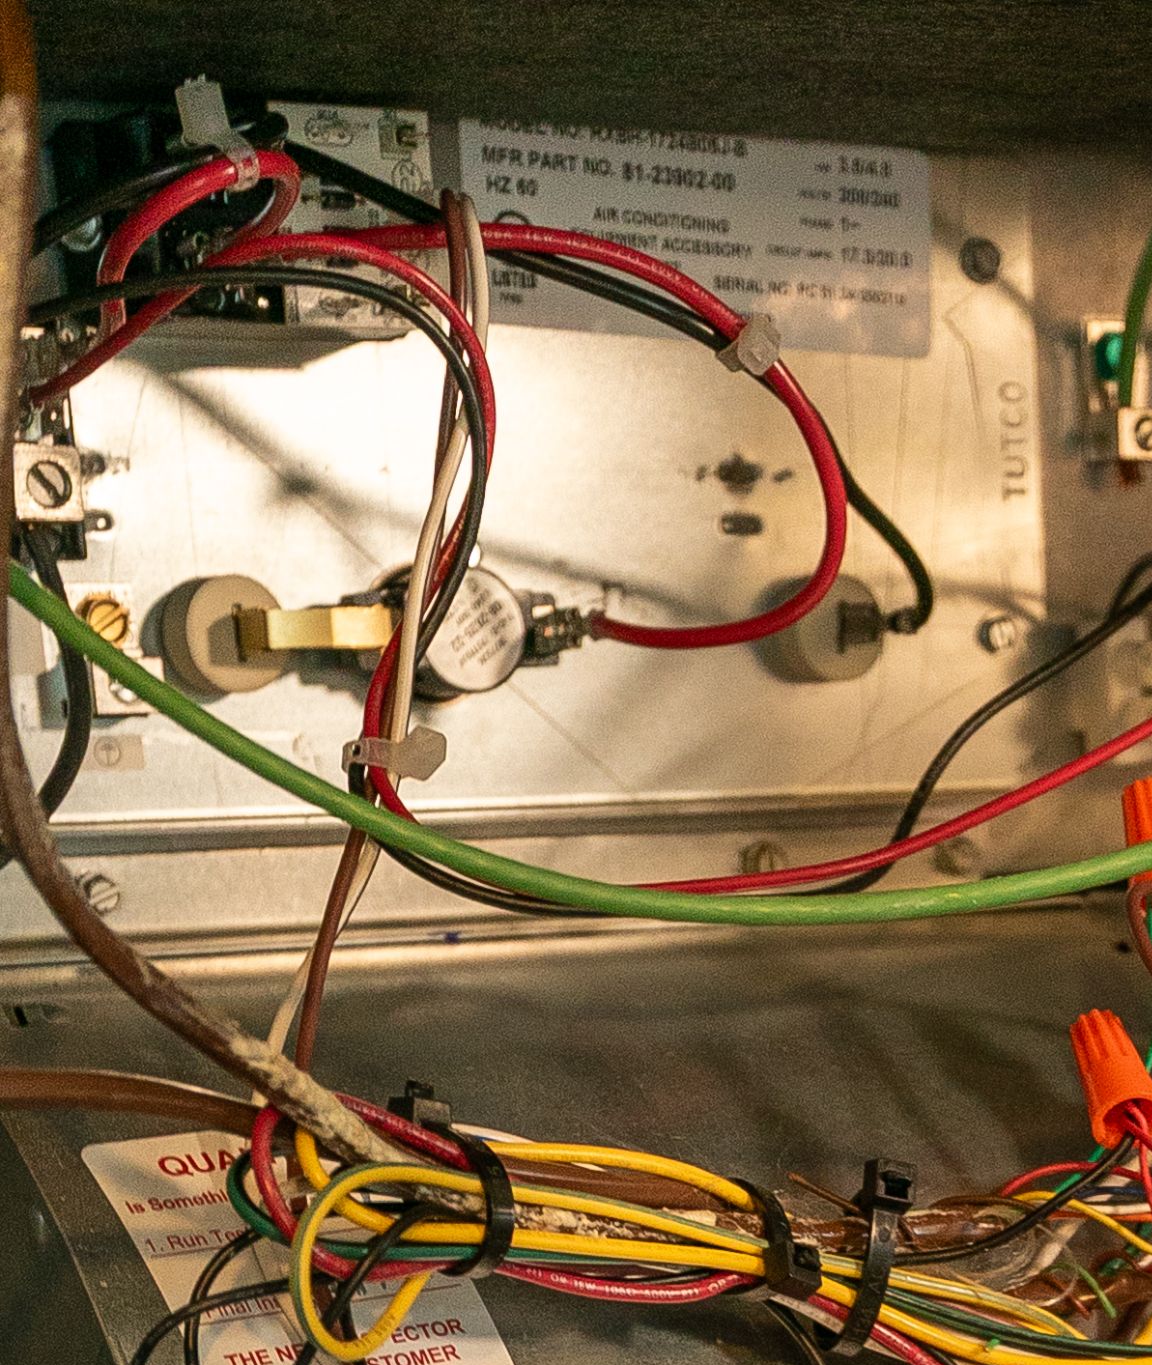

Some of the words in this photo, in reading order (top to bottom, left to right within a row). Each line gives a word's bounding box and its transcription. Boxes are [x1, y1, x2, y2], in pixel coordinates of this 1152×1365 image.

[528, 150, 577, 172] PART
[998, 381, 1029, 502] TUTCO
[167, 1235, 208, 1251] Run
